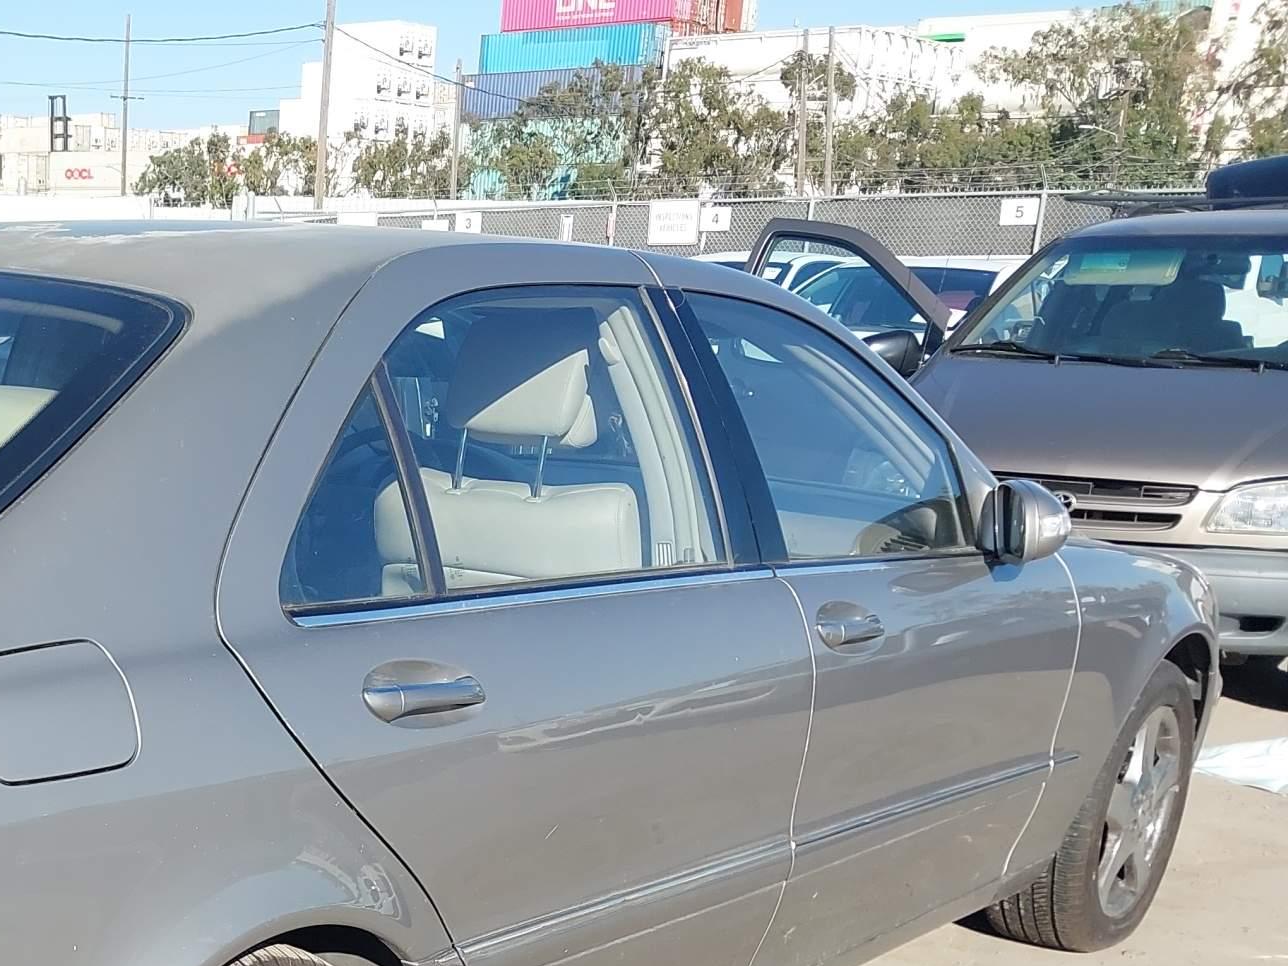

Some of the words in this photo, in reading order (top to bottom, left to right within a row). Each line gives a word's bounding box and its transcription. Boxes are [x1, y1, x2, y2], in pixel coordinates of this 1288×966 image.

[65, 168, 94, 180] OOCL
[1015, 205, 1024, 218] 5
[465, 217, 472, 230] 3
[712, 213, 719, 225] 4
